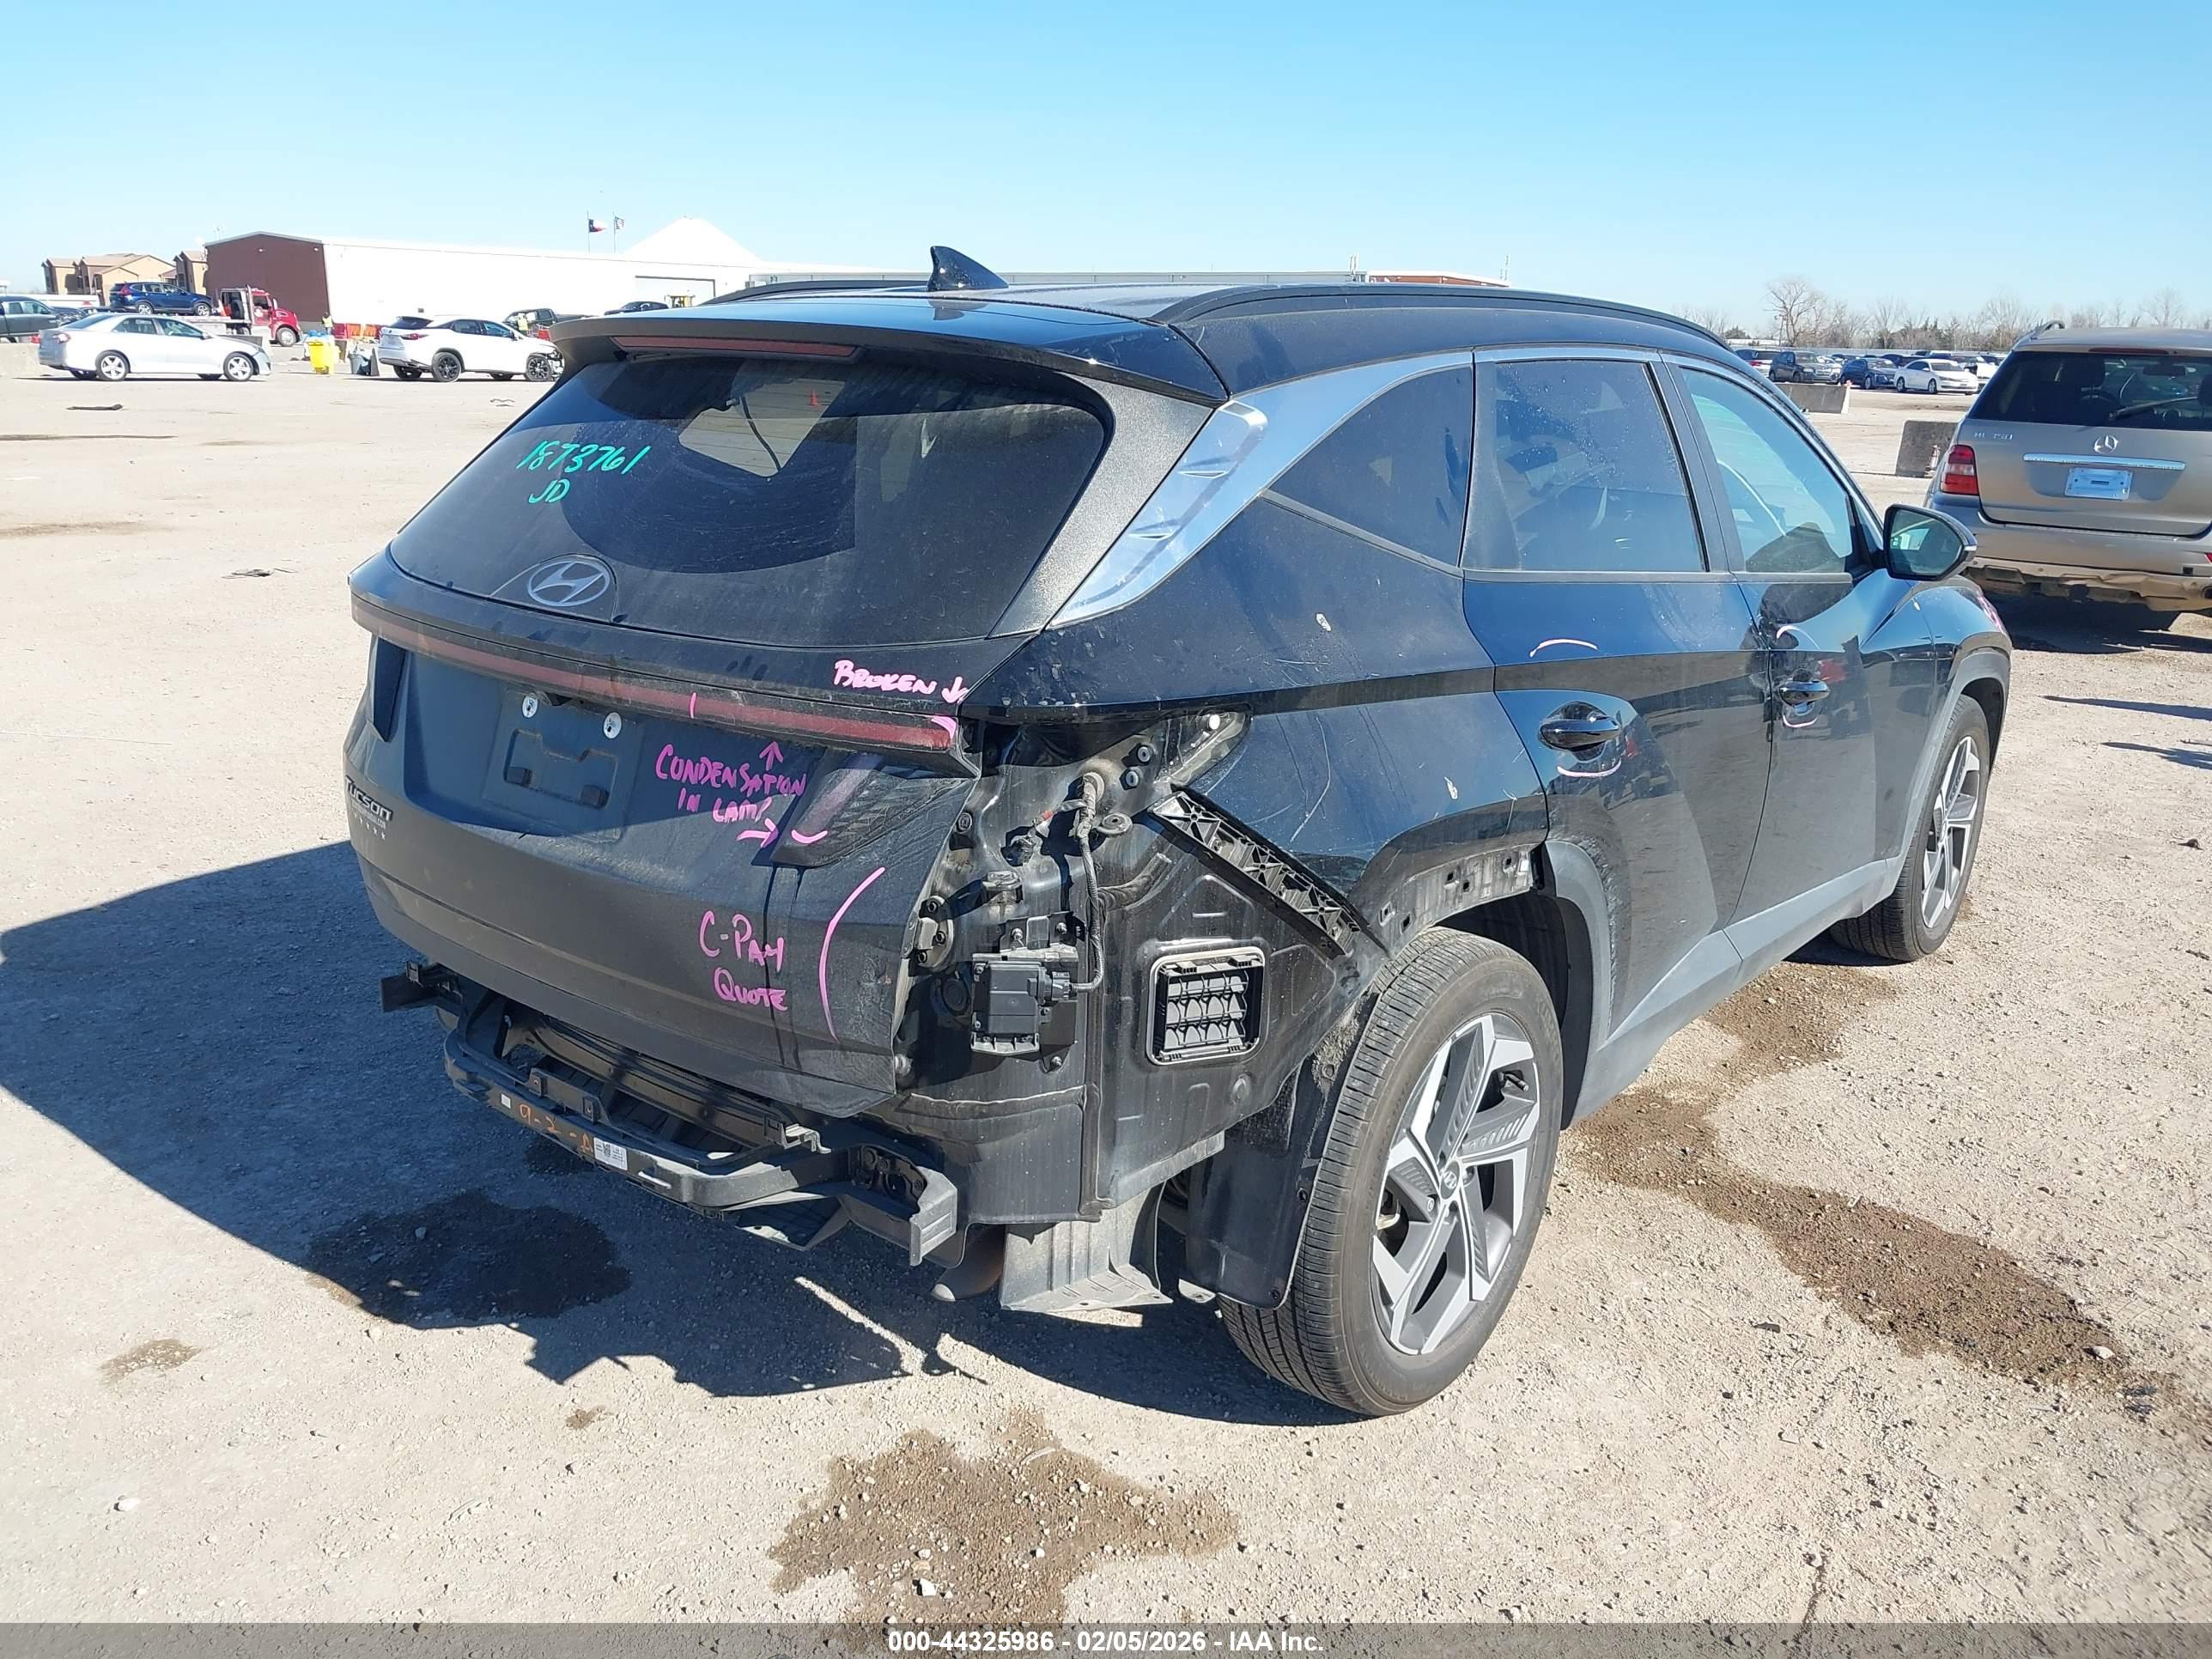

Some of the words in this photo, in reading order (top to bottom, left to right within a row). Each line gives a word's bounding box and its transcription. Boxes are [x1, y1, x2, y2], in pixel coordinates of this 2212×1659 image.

[528, 478, 571, 503] JD
[833, 659, 938, 695] BROKEN
[655, 744, 806, 797] CONDENSATION
[678, 787, 702, 812] IN
[712, 796, 772, 823] LAMP
[714, 967, 788, 1012] QUOTE
